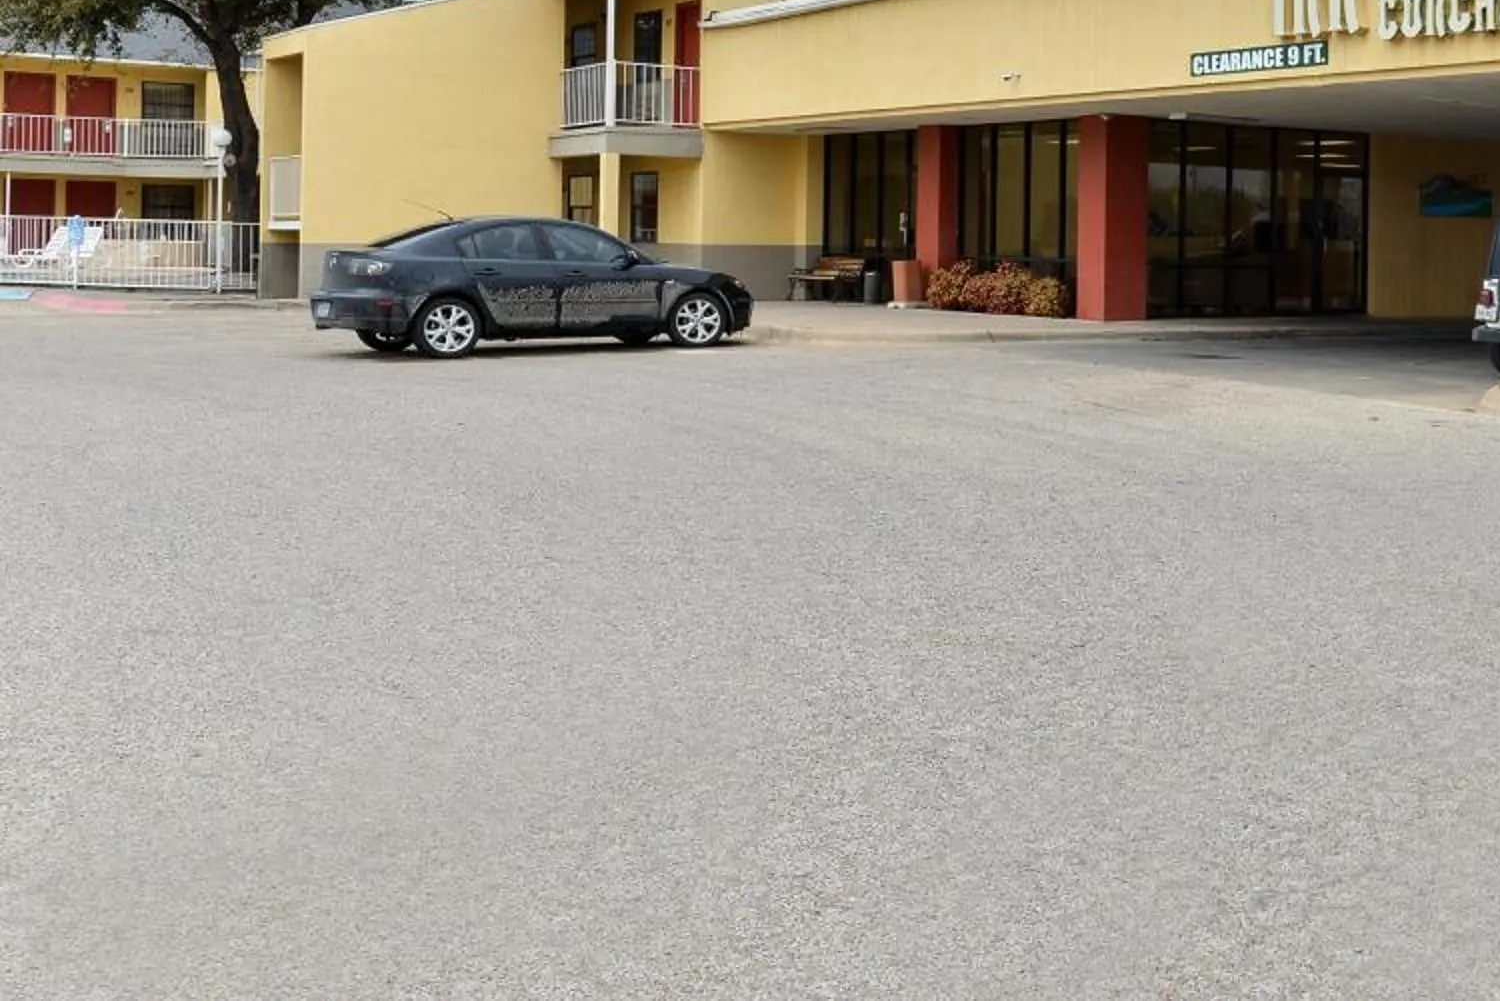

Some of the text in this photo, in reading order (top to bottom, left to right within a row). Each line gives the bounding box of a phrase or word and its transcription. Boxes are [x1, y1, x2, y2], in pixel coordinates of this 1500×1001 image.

[1192, 42, 1326, 75] CLEARANCE 9 FT.
